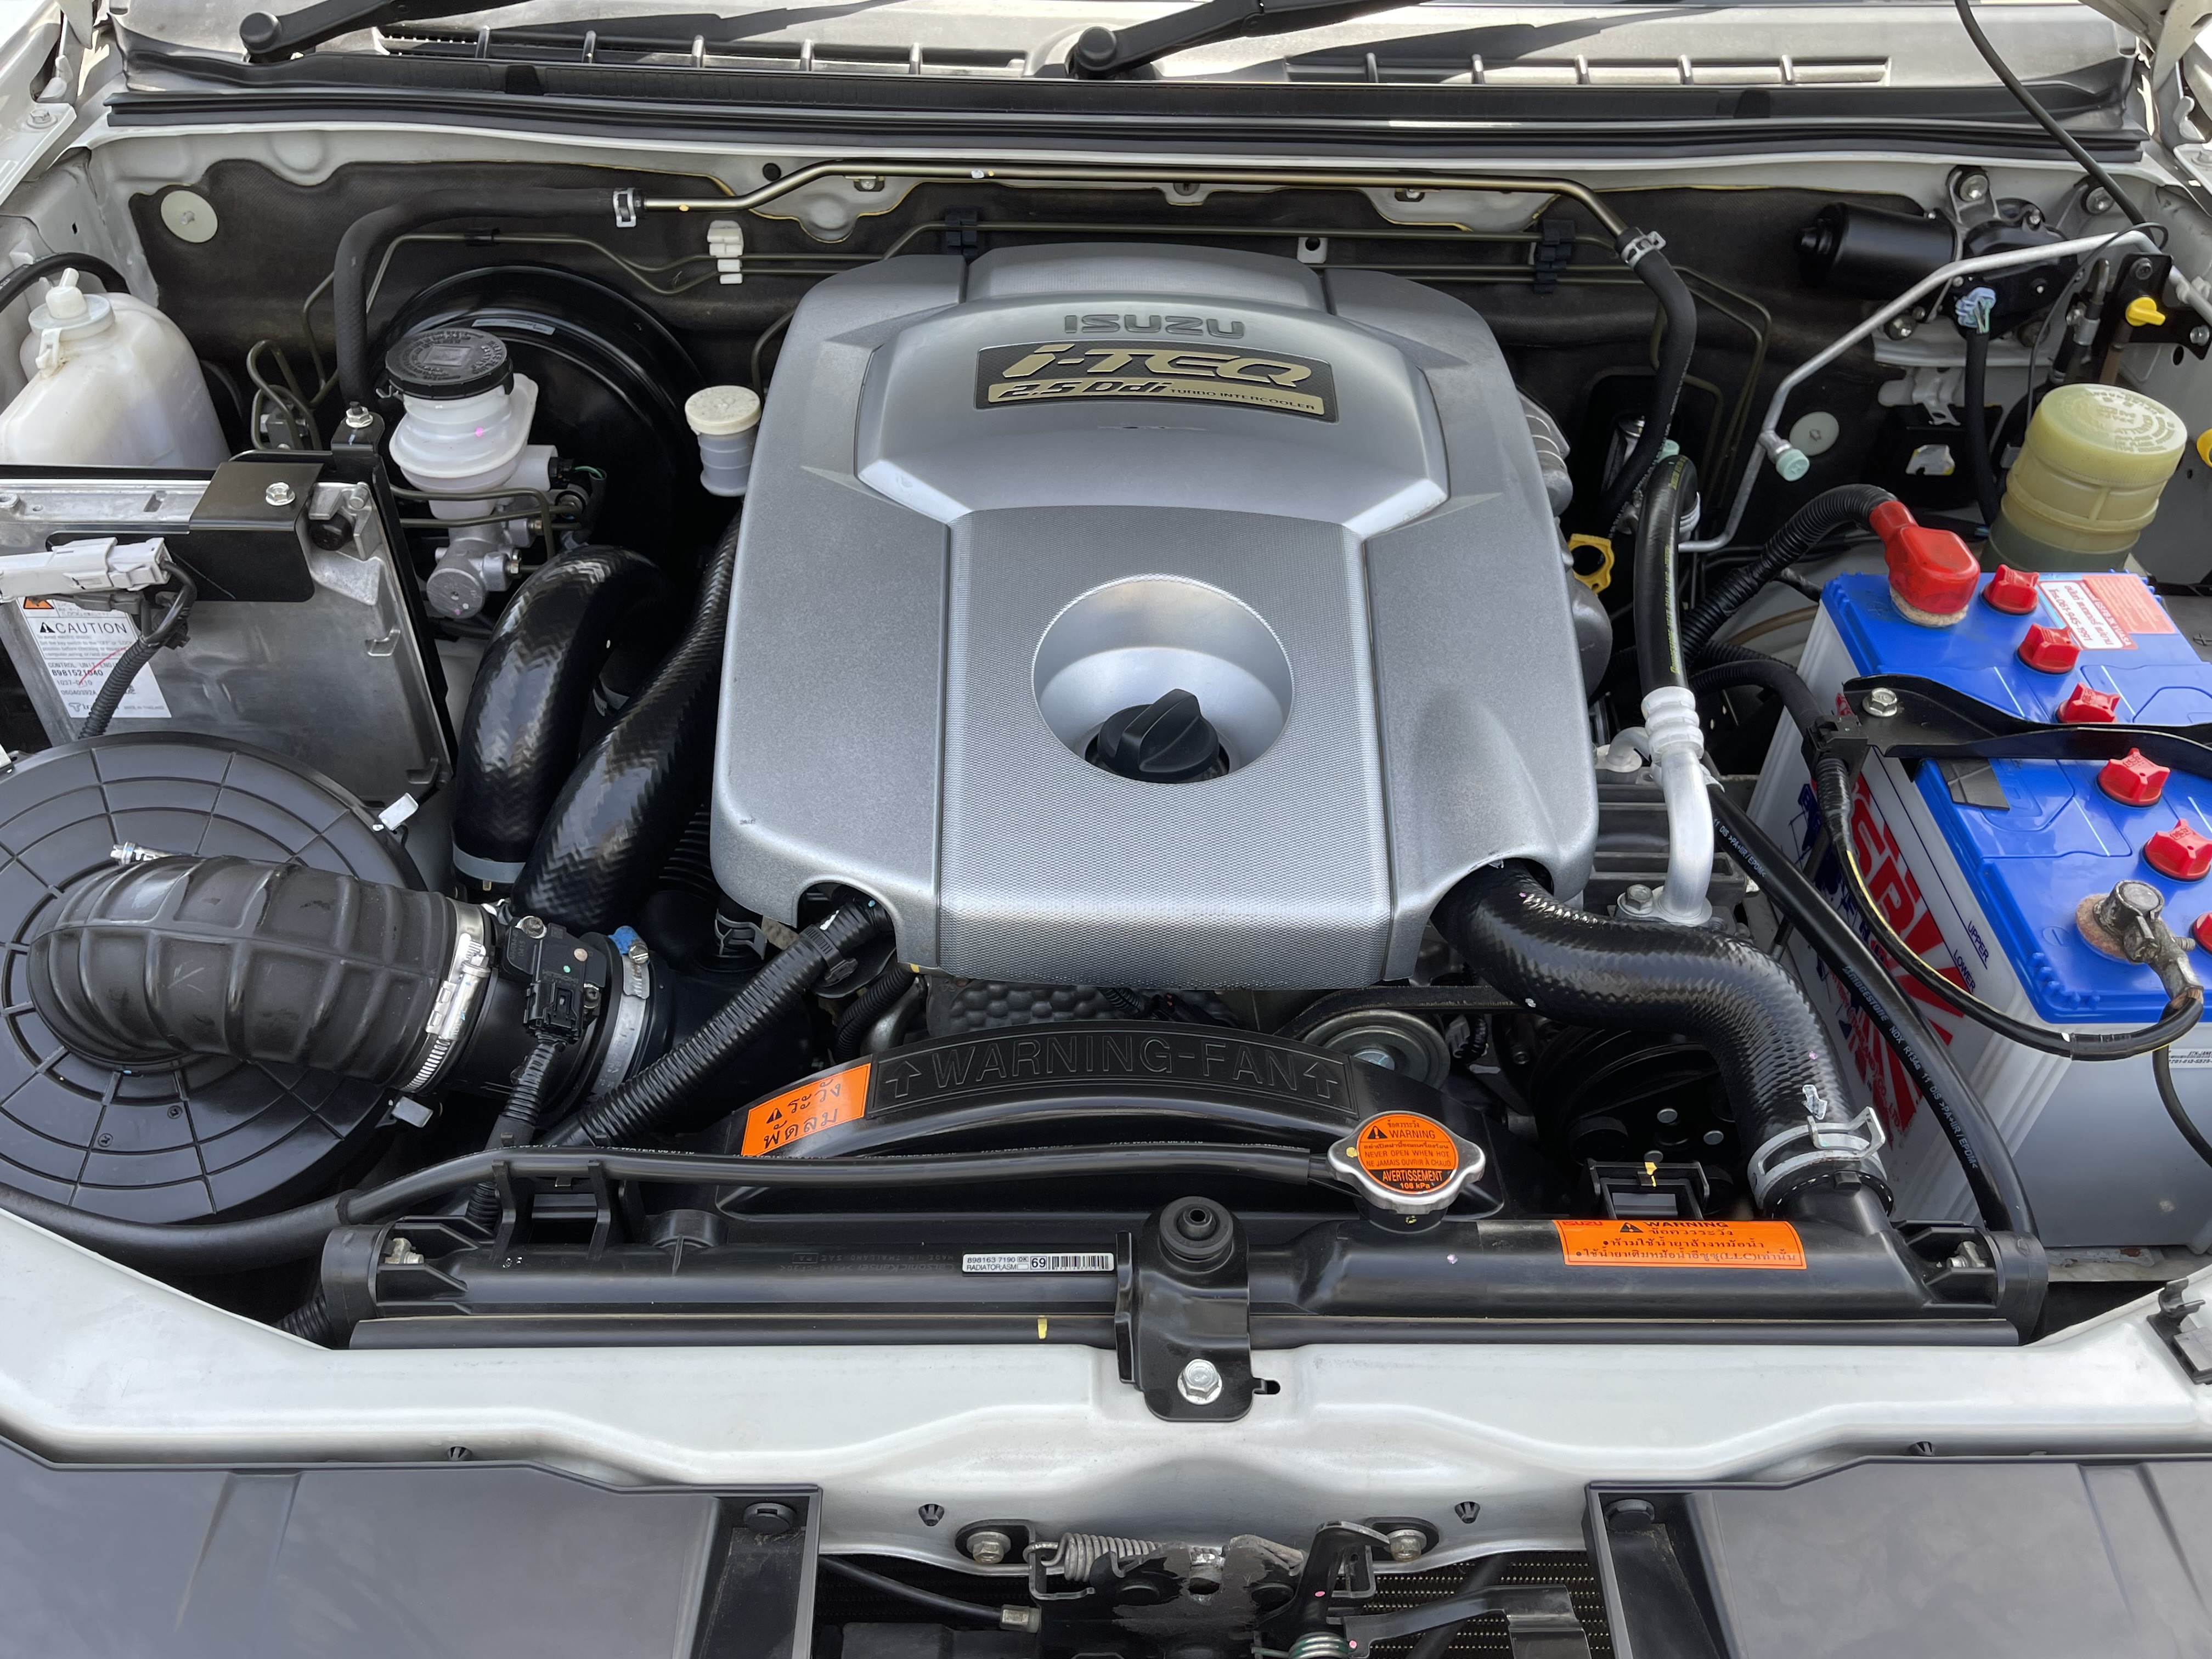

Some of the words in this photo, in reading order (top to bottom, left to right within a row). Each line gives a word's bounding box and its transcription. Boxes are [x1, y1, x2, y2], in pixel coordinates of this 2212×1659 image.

[1064, 314, 1246, 340] ISUZU
[1002, 343, 1313, 388] i-TEQ
[1169, 388, 1217, 397] TURBO
[1219, 391, 1316, 411] INTERCOOLER
[55, 623, 127, 633] CAUTION
[1967, 919, 1990, 962] UPPER
[1953, 948, 1977, 992] LOWER
[1889, 1025, 1905, 1045] NDX
[1903, 1045, 1921, 1070] R134a
[1929, 1085, 1942, 1101] DIS
[787, 1078, 841, 1114] ระวัง
[763, 1108, 838, 1149] พัดลม
[1387, 1119, 1420, 1128] ข้อควรระวัง
[1389, 1129, 1436, 1139] WARNING
[1425, 1158, 1431, 1166] À
[1383, 1169, 1443, 1182] AVERTISSEMENT
[1649, 1227, 1734, 1235] ข้อควรระวัง
[1031, 1257, 1046, 1268] 69
